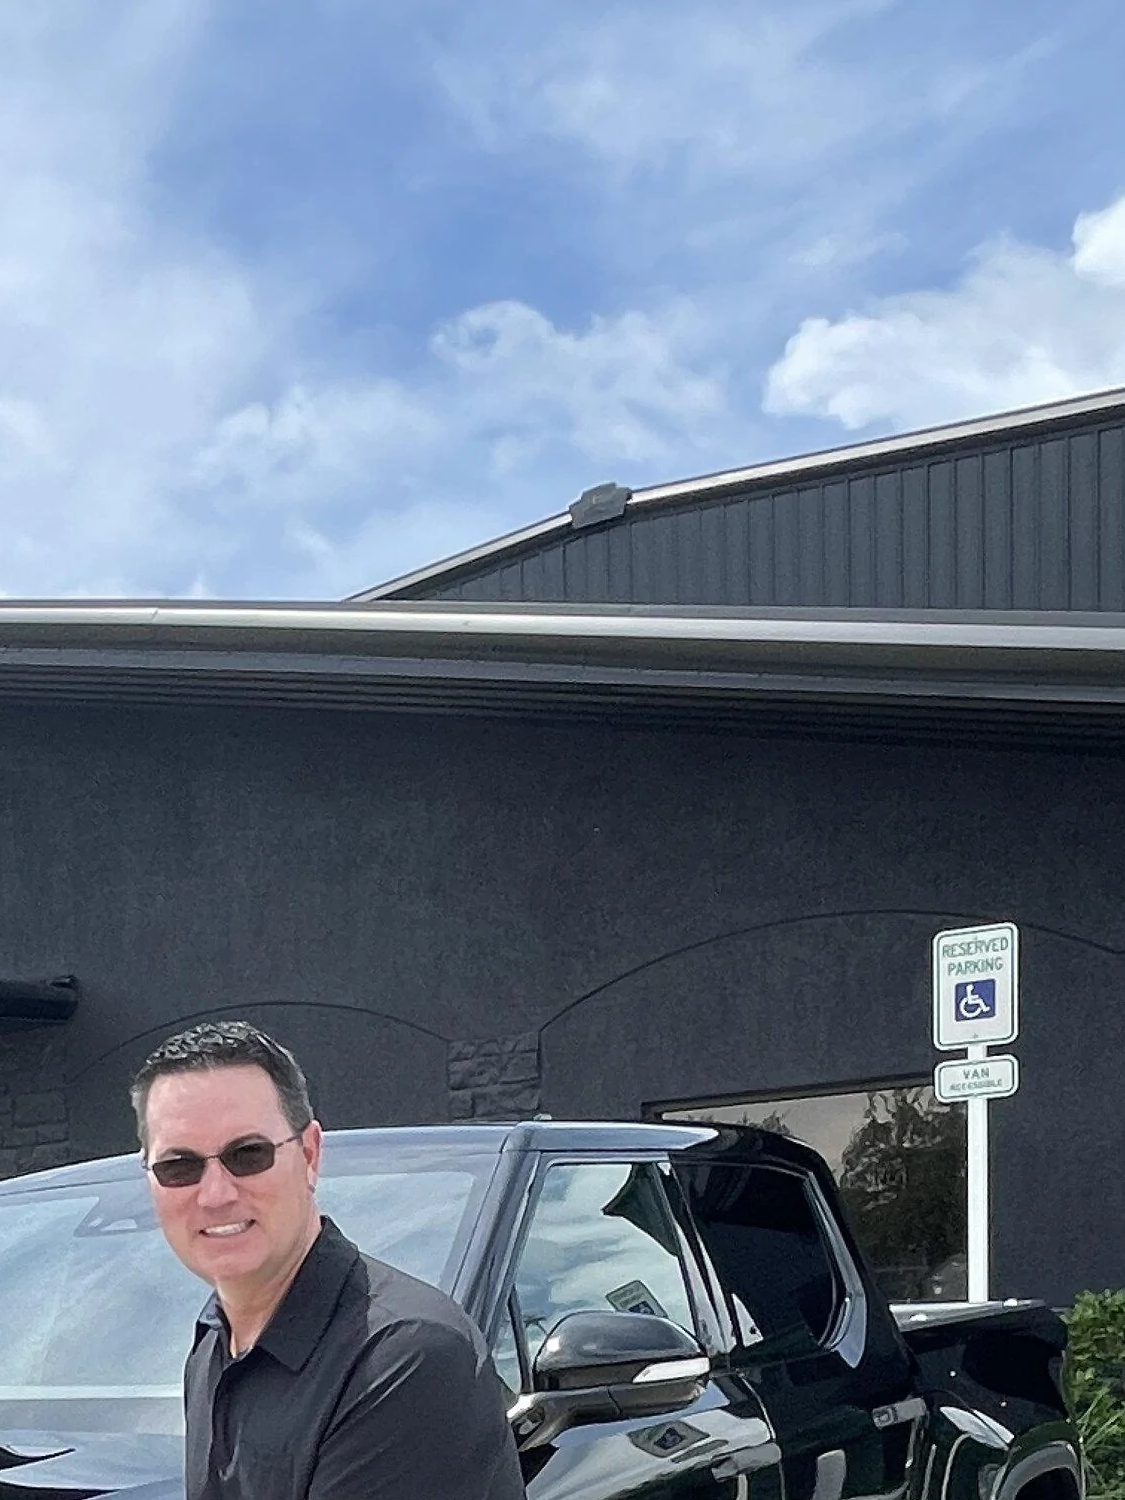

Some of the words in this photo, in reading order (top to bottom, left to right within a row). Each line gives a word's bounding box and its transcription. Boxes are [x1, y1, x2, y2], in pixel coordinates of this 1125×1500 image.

[942, 937, 1009, 958] RESERVED
[947, 956, 1004, 976] PARKING
[963, 1067, 990, 1079] VAN
